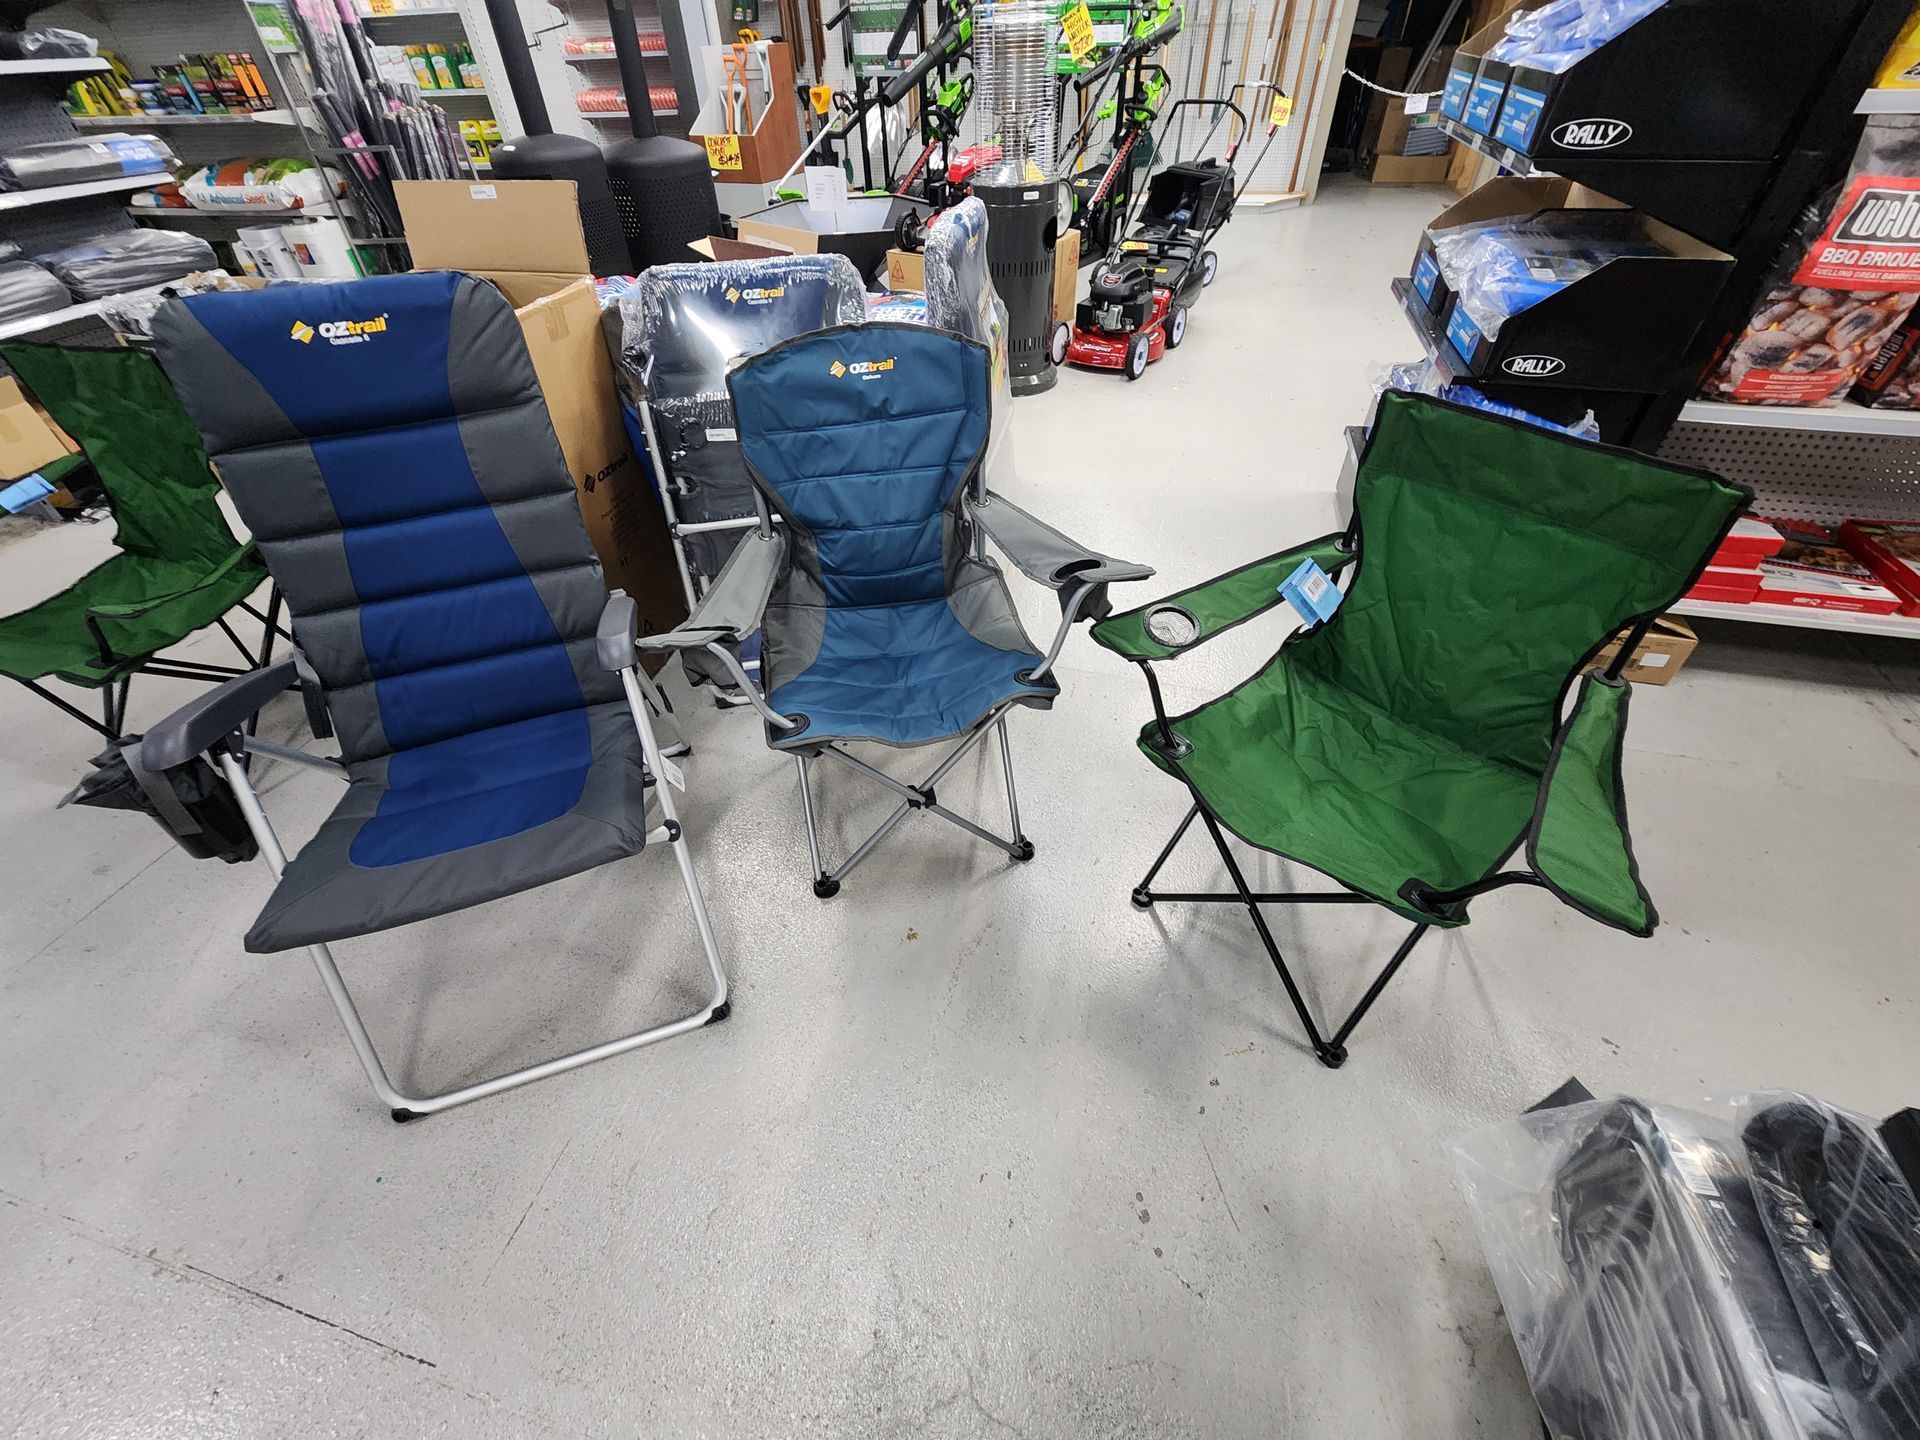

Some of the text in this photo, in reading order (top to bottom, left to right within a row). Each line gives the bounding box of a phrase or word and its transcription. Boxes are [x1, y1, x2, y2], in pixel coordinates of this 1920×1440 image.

[1562, 124, 1624, 145] RALLY
[1818, 247, 1920, 268] BBQ BRIQUE
[1811, 267, 1854, 278] FUELLING
[1853, 270, 1882, 279] GREAT
[742, 286, 785, 300] OZtrail
[318, 316, 387, 338] OZtrail
[849, 358, 894, 374] OZtrail
[1511, 358, 1559, 374] RALLY
